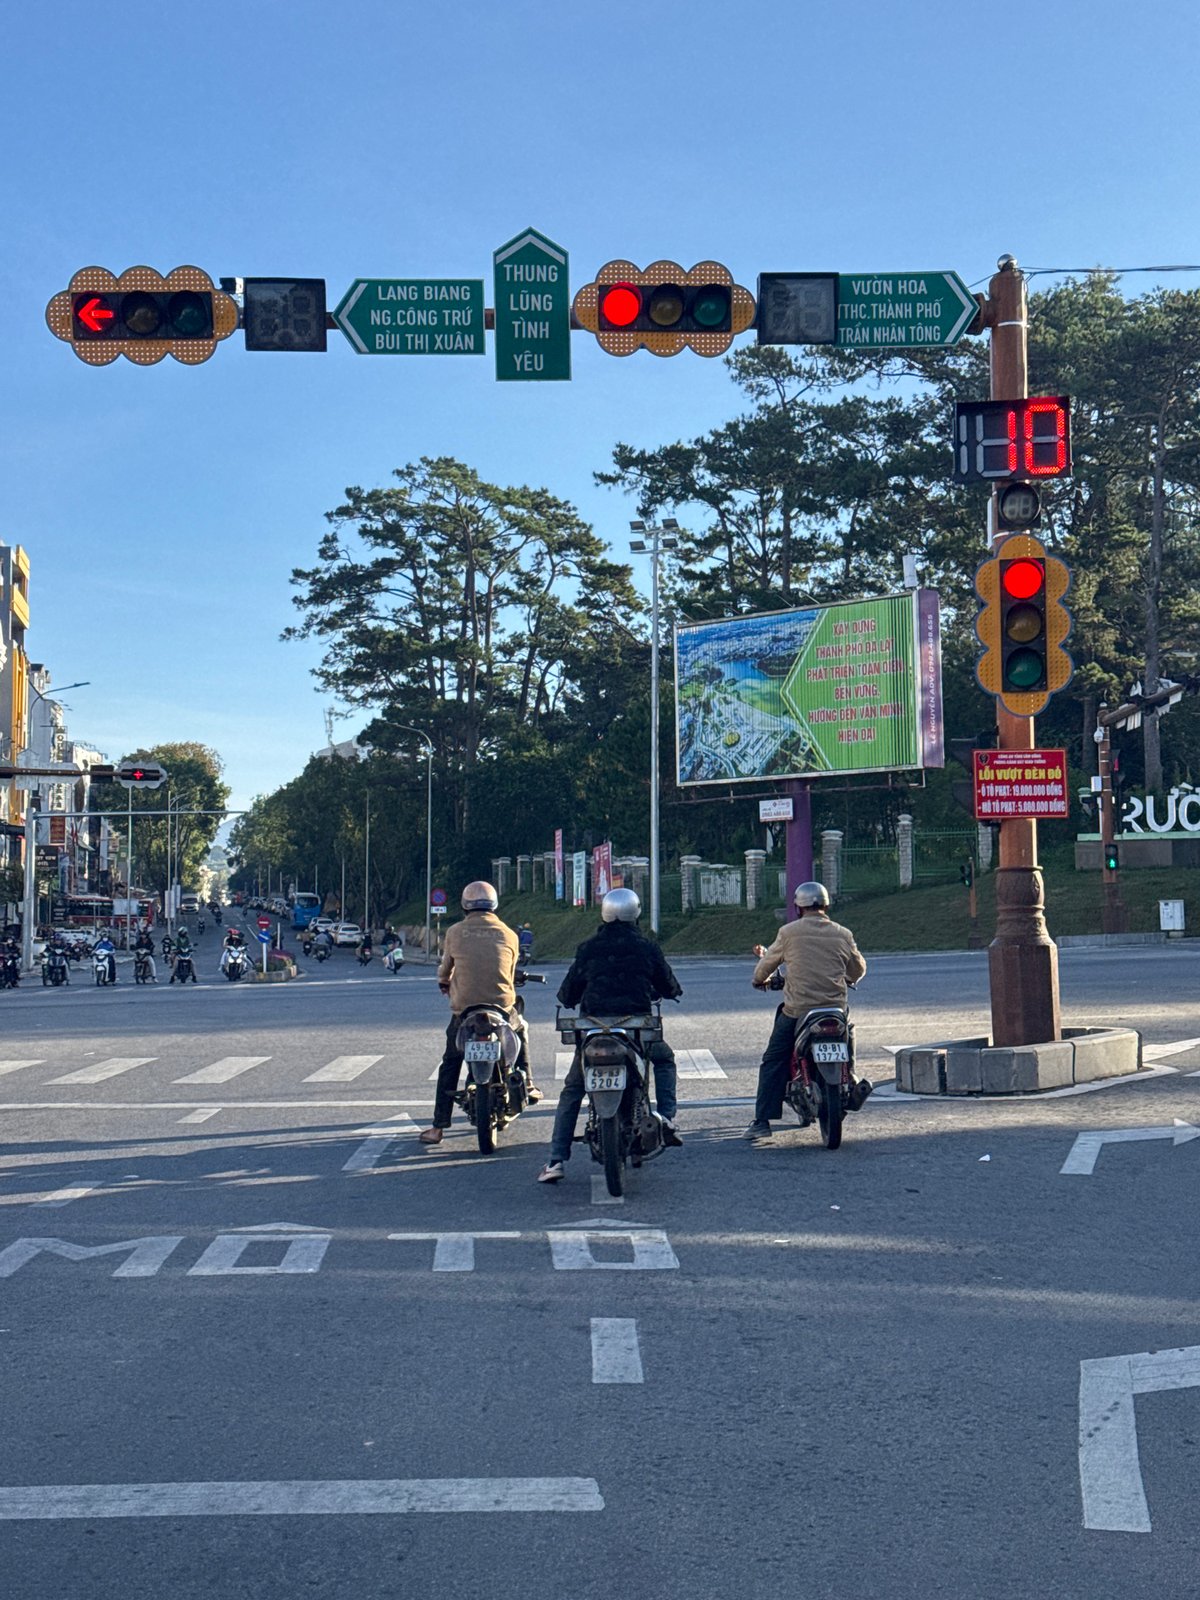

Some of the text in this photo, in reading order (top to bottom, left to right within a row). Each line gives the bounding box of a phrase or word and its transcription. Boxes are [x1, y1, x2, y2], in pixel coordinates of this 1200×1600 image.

[503, 264, 559, 282] THUNG
[377, 285, 471, 301] LANG BIANG
[851, 275, 928, 295] VƯỜN HOA
[509, 289, 553, 312] LŨNG
[916, 296, 944, 319] PHỐ
[370, 305, 473, 326] NG.CÔNG TRỨ
[511, 316, 550, 339] TÌNH
[873, 322, 906, 344] NHÂN
[908, 322, 941, 343] TÔNG
[375, 329, 475, 353] BÙI THỊ XUÂN
[513, 350, 545, 372] YÊU
[1007, 403, 1066, 475] 10
[978, 765, 1062, 782] LỖI VƯỢT ĐÈN ĐỎ
[591, 1078, 620, 1089] 5204
[387, 1217, 680, 1272] TÔ
